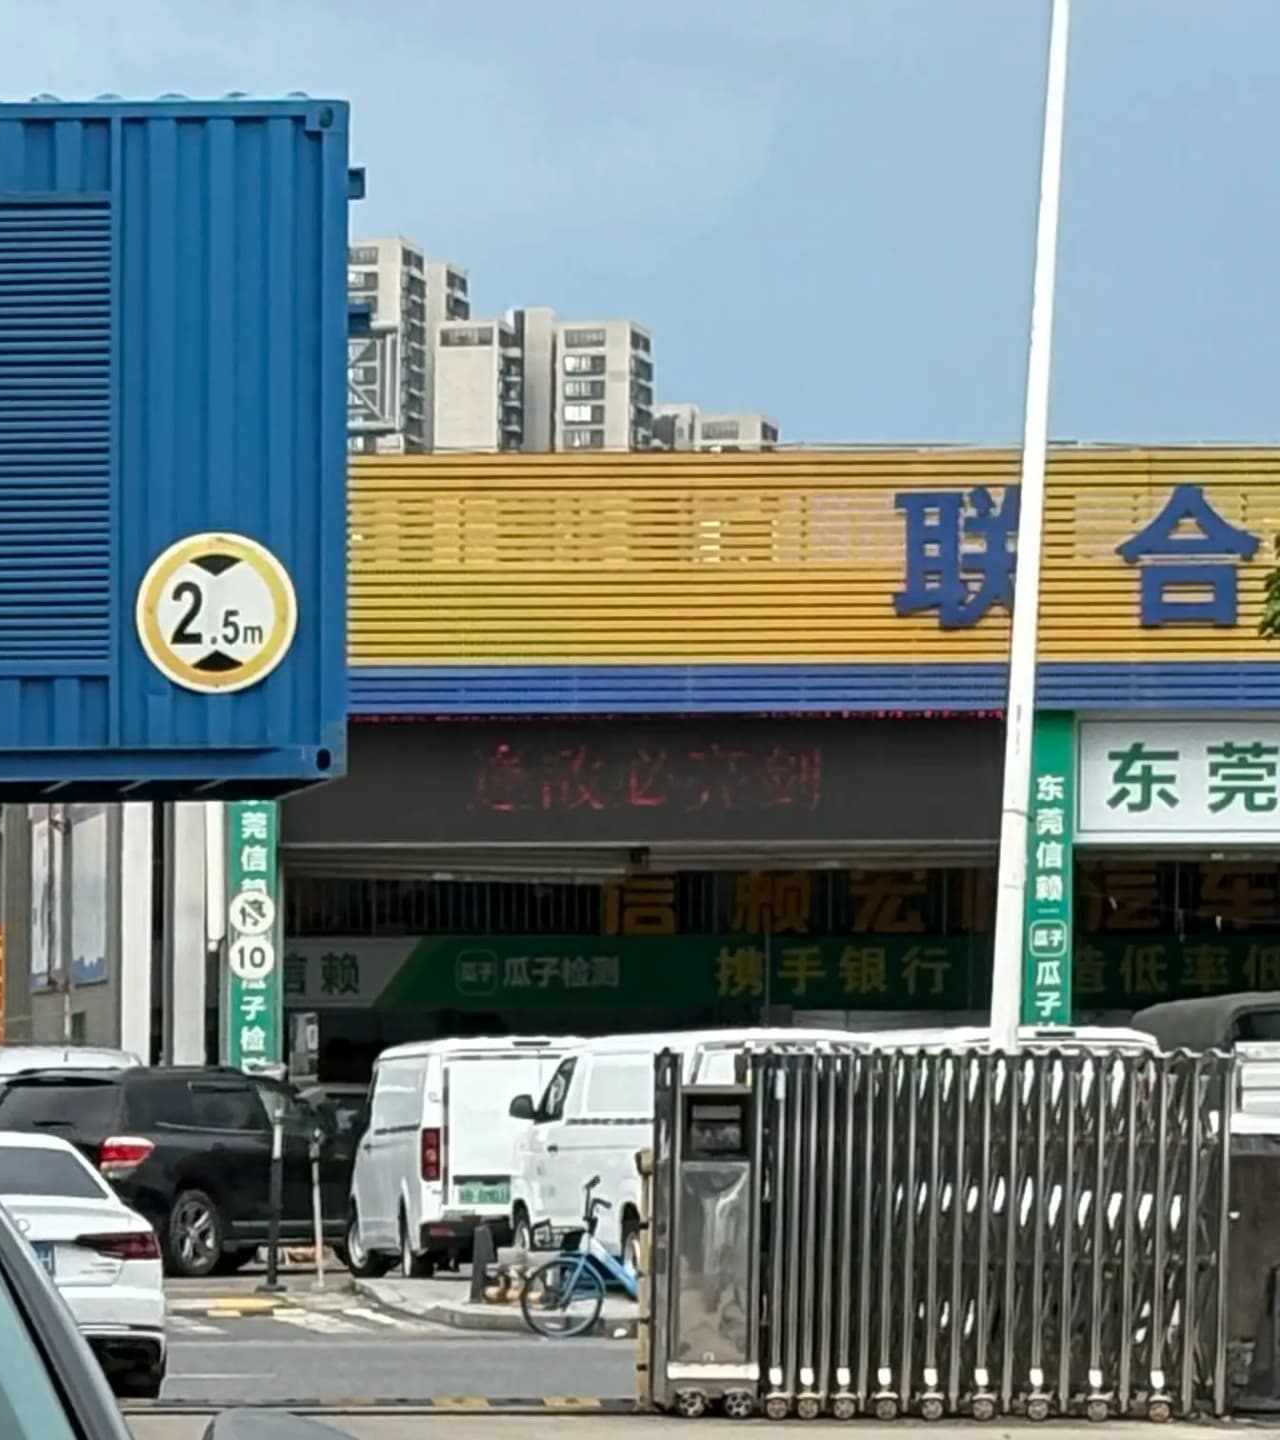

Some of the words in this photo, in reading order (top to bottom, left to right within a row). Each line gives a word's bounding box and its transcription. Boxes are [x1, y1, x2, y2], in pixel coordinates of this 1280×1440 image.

[1034, 774, 1065, 901] 东莞信赖
[238, 945, 267, 970] 10
